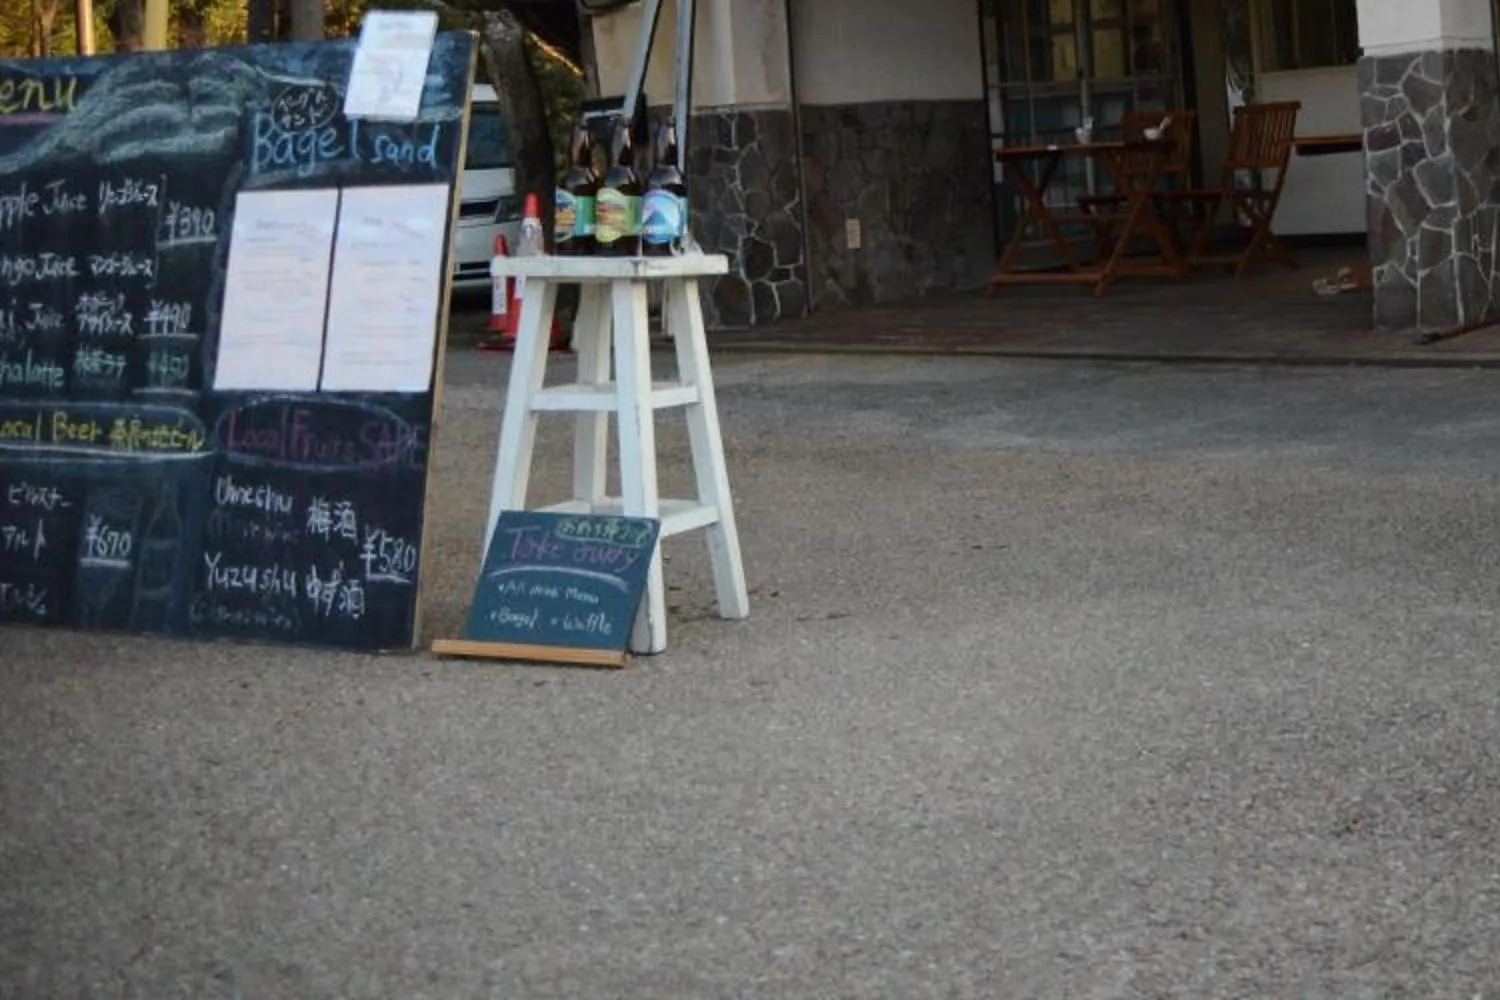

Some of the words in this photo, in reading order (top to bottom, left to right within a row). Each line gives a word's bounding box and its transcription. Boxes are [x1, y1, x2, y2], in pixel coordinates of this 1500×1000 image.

[0, 76, 79, 114] enu
[253, 112, 361, 178] Bagel
[369, 123, 441, 170] sand
[0, 182, 40, 231] pple
[165, 200, 215, 243] ¥390
[1, 254, 36, 286] ngo
[0, 411, 42, 443] ocal
[52, 411, 102, 444] Beer
[85, 513, 132, 558] ¥670
[216, 475, 294, 515] Umeshu
[307, 496, 358, 545] 梅酒
[360, 523, 416, 577] ¥580
[504, 525, 562, 561] Take
[571, 543, 640, 573] away
[204, 551, 297, 599] Yuzushu
[305, 560, 365, 619] ゆず酒
